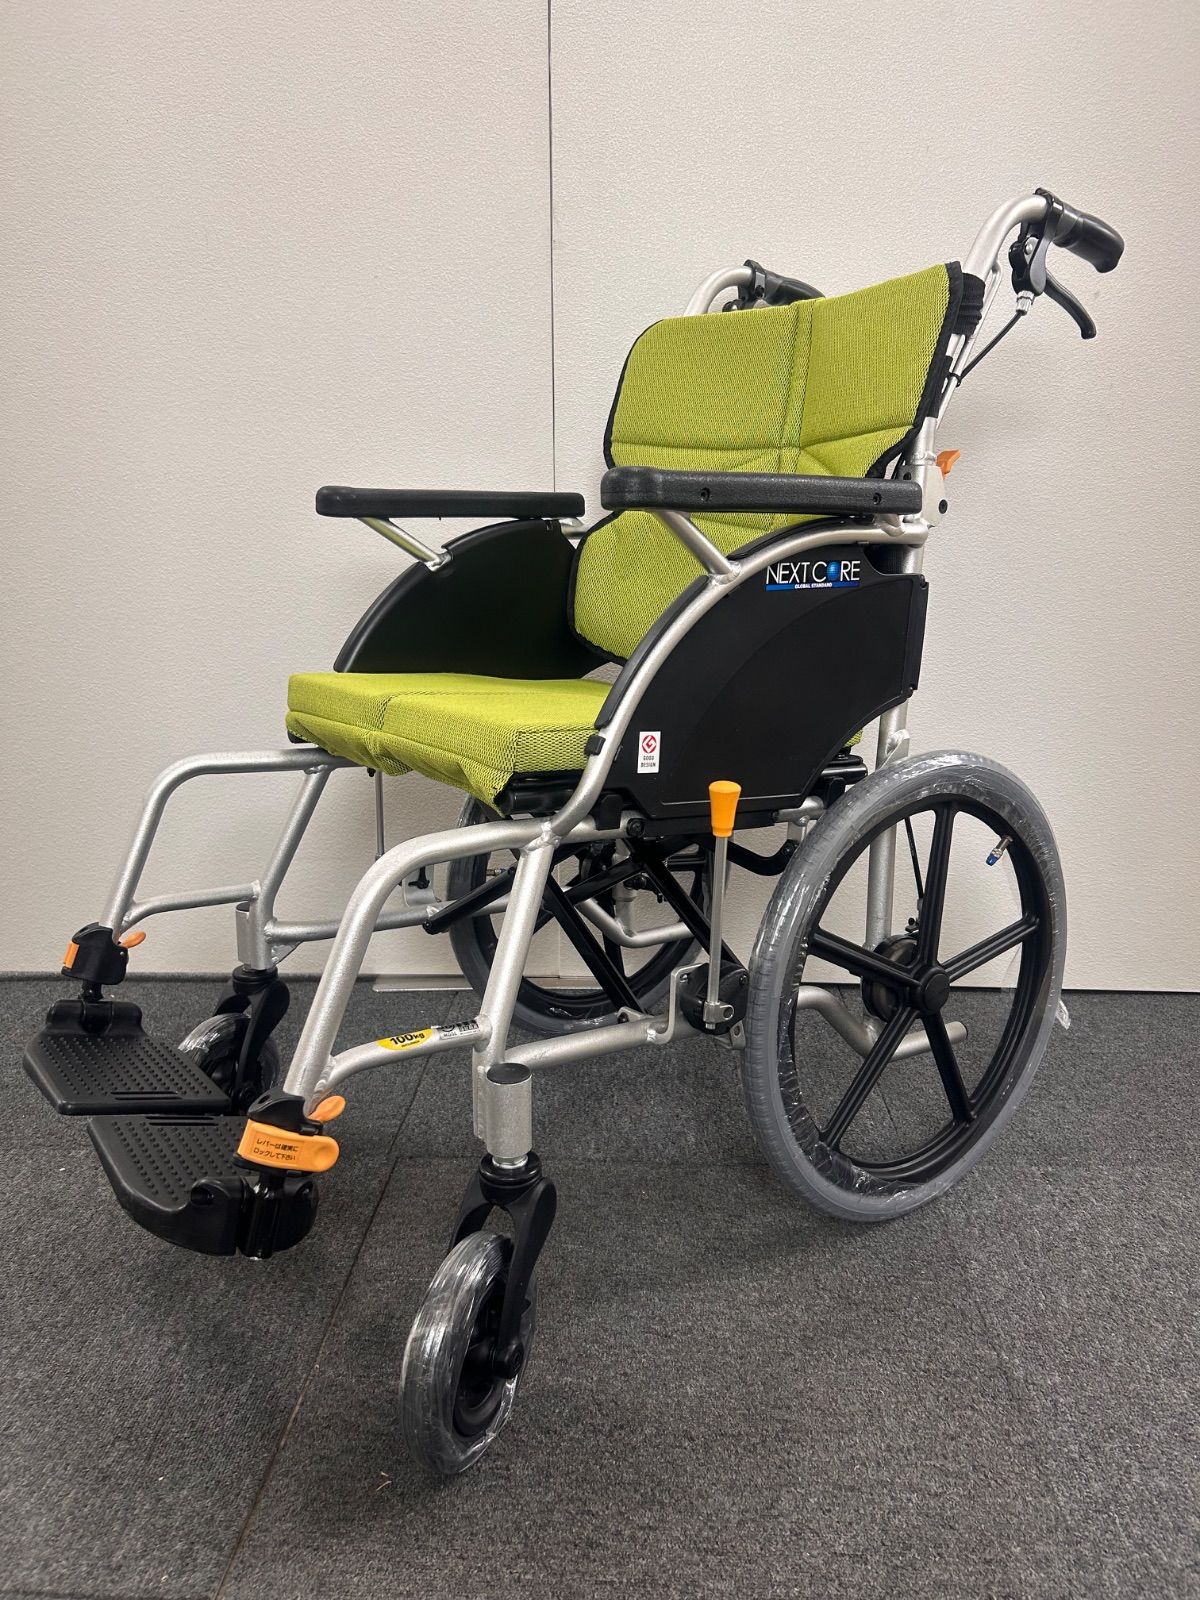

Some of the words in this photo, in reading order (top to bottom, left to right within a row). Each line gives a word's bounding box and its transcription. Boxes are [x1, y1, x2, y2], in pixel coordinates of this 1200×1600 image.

[766, 562, 810, 584] NEXT
[812, 561, 861, 582] CORE
[389, 1032, 425, 1045] 100kg
[253, 1147, 296, 1160] ロックして下さい
